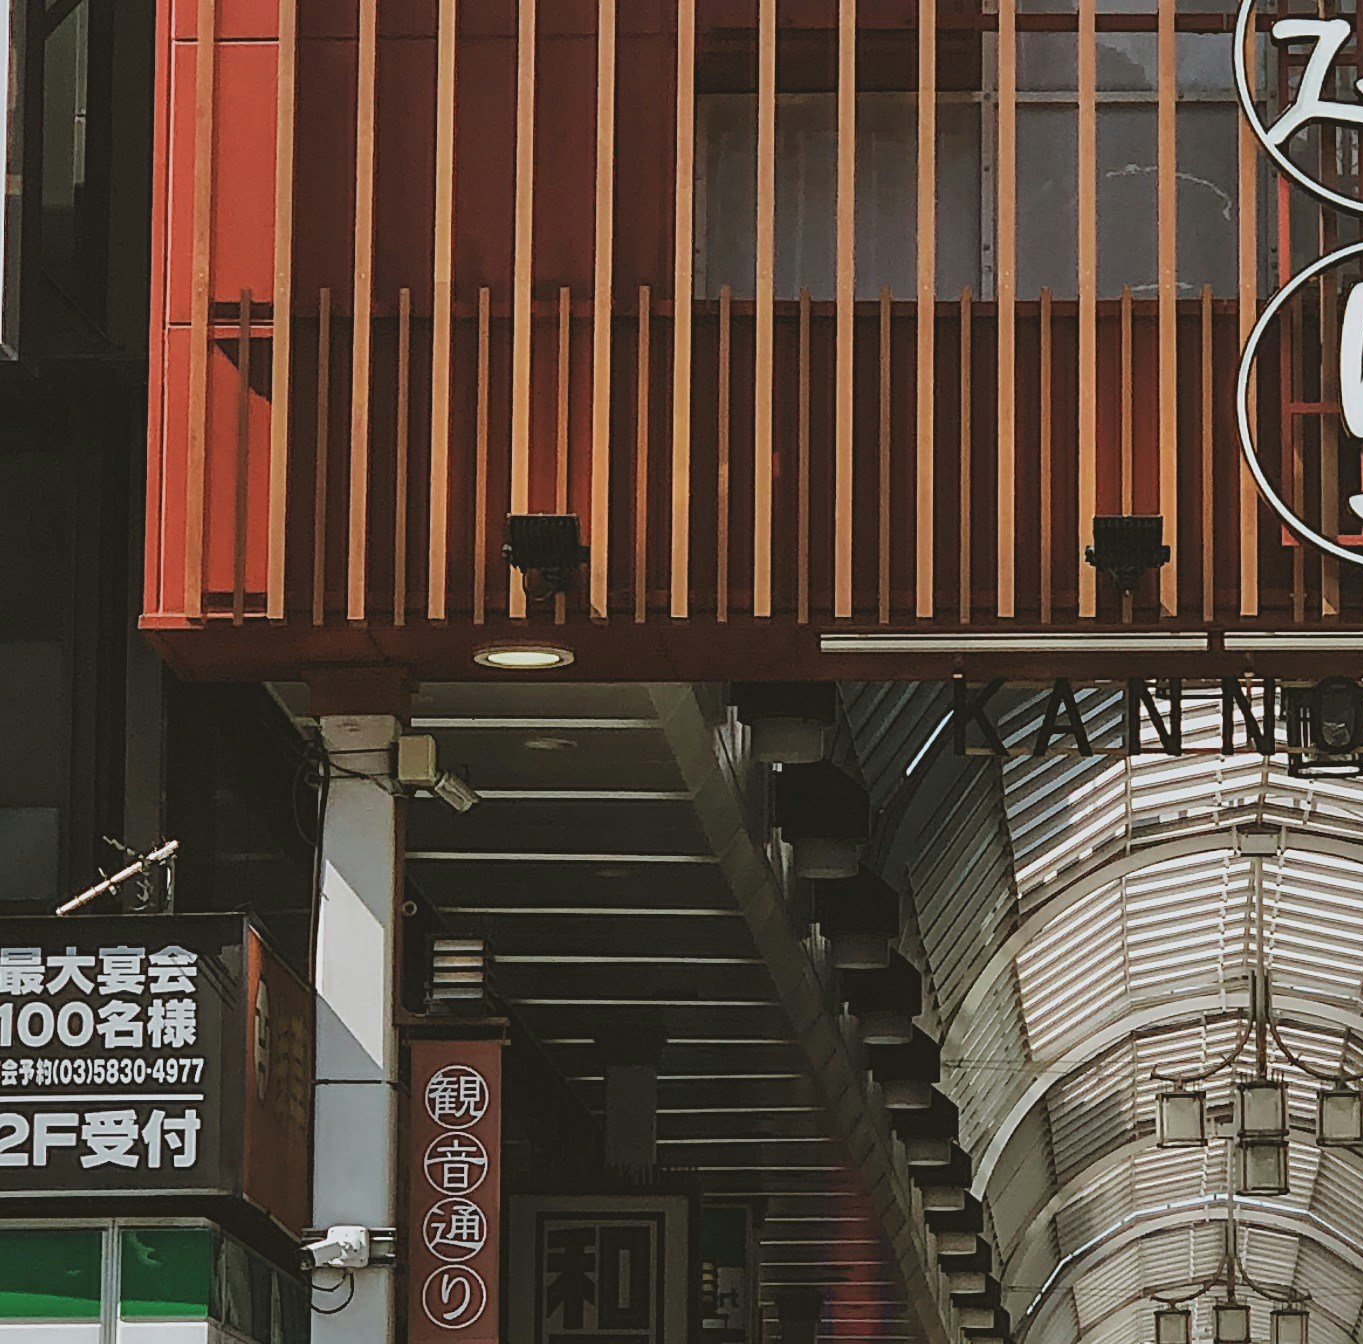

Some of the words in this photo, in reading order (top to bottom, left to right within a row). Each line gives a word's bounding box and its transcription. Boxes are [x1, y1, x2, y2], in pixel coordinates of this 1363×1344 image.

[0, 944, 197, 996] 最大宴会
[0, 1001, 197, 1049] 100名様
[0, 1108, 202, 1169] 2F受付
[426, 1067, 486, 1323] 観音通り
